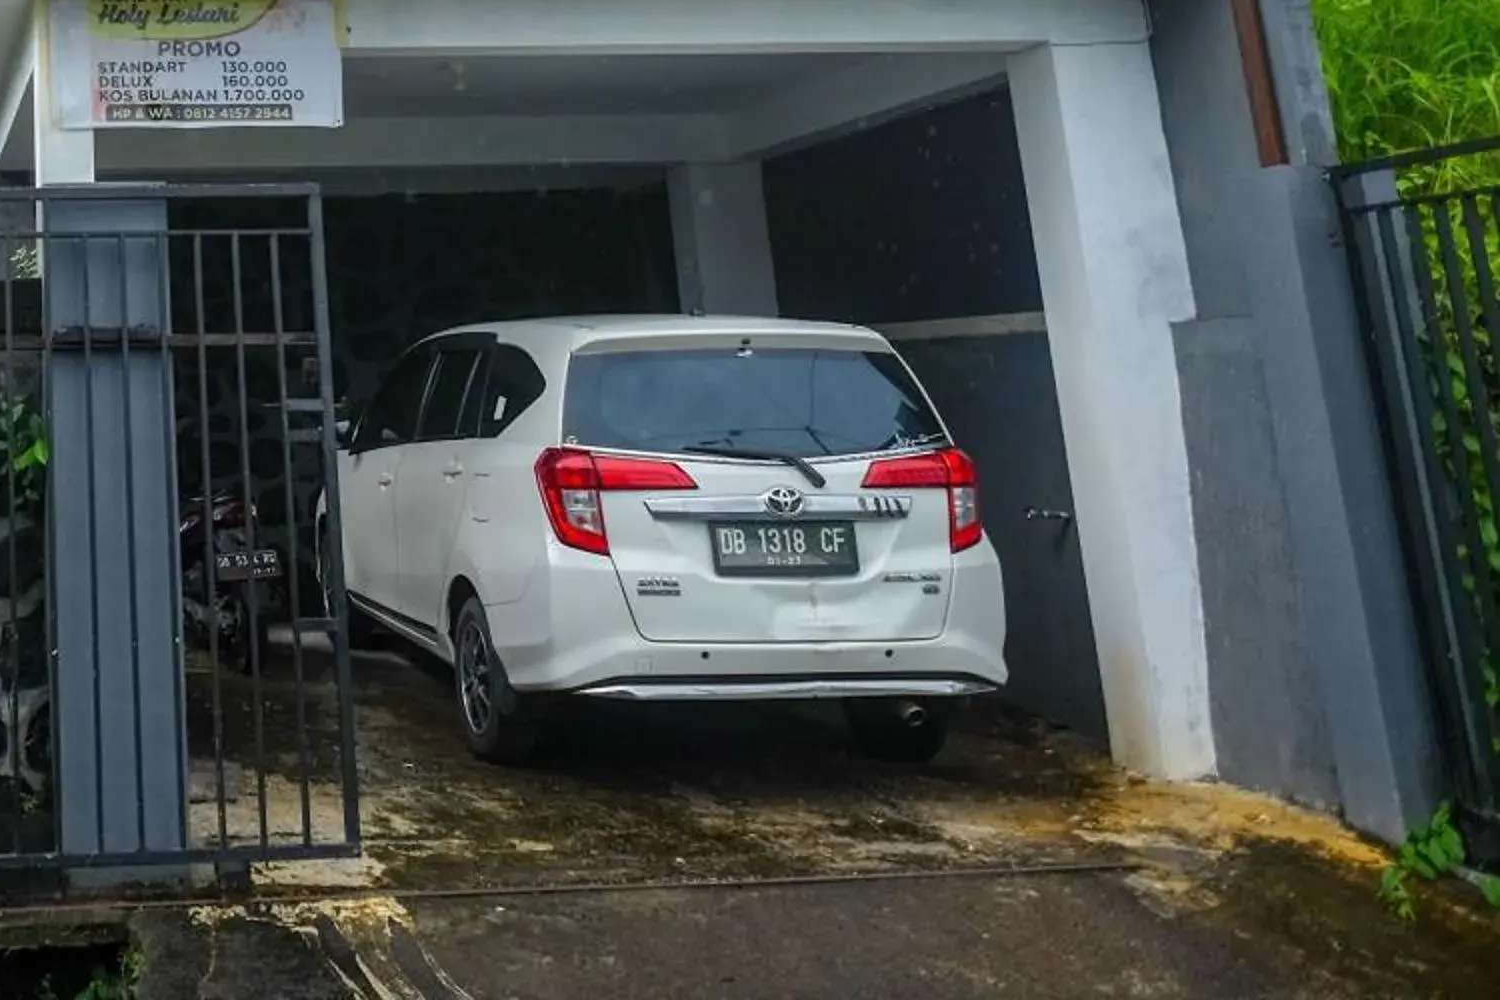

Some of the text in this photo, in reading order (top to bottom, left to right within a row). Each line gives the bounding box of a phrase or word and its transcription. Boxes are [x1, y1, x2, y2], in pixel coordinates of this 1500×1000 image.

[158, 41, 241, 57] PROMO
[97, 61, 287, 74] STANDART 130.000
[99, 75, 288, 88] DELUX 160.000
[100, 89, 304, 101] KOS BULANAN 1.700.000
[149, 107, 173, 119] WA
[719, 527, 845, 554] DB 1318 CF
